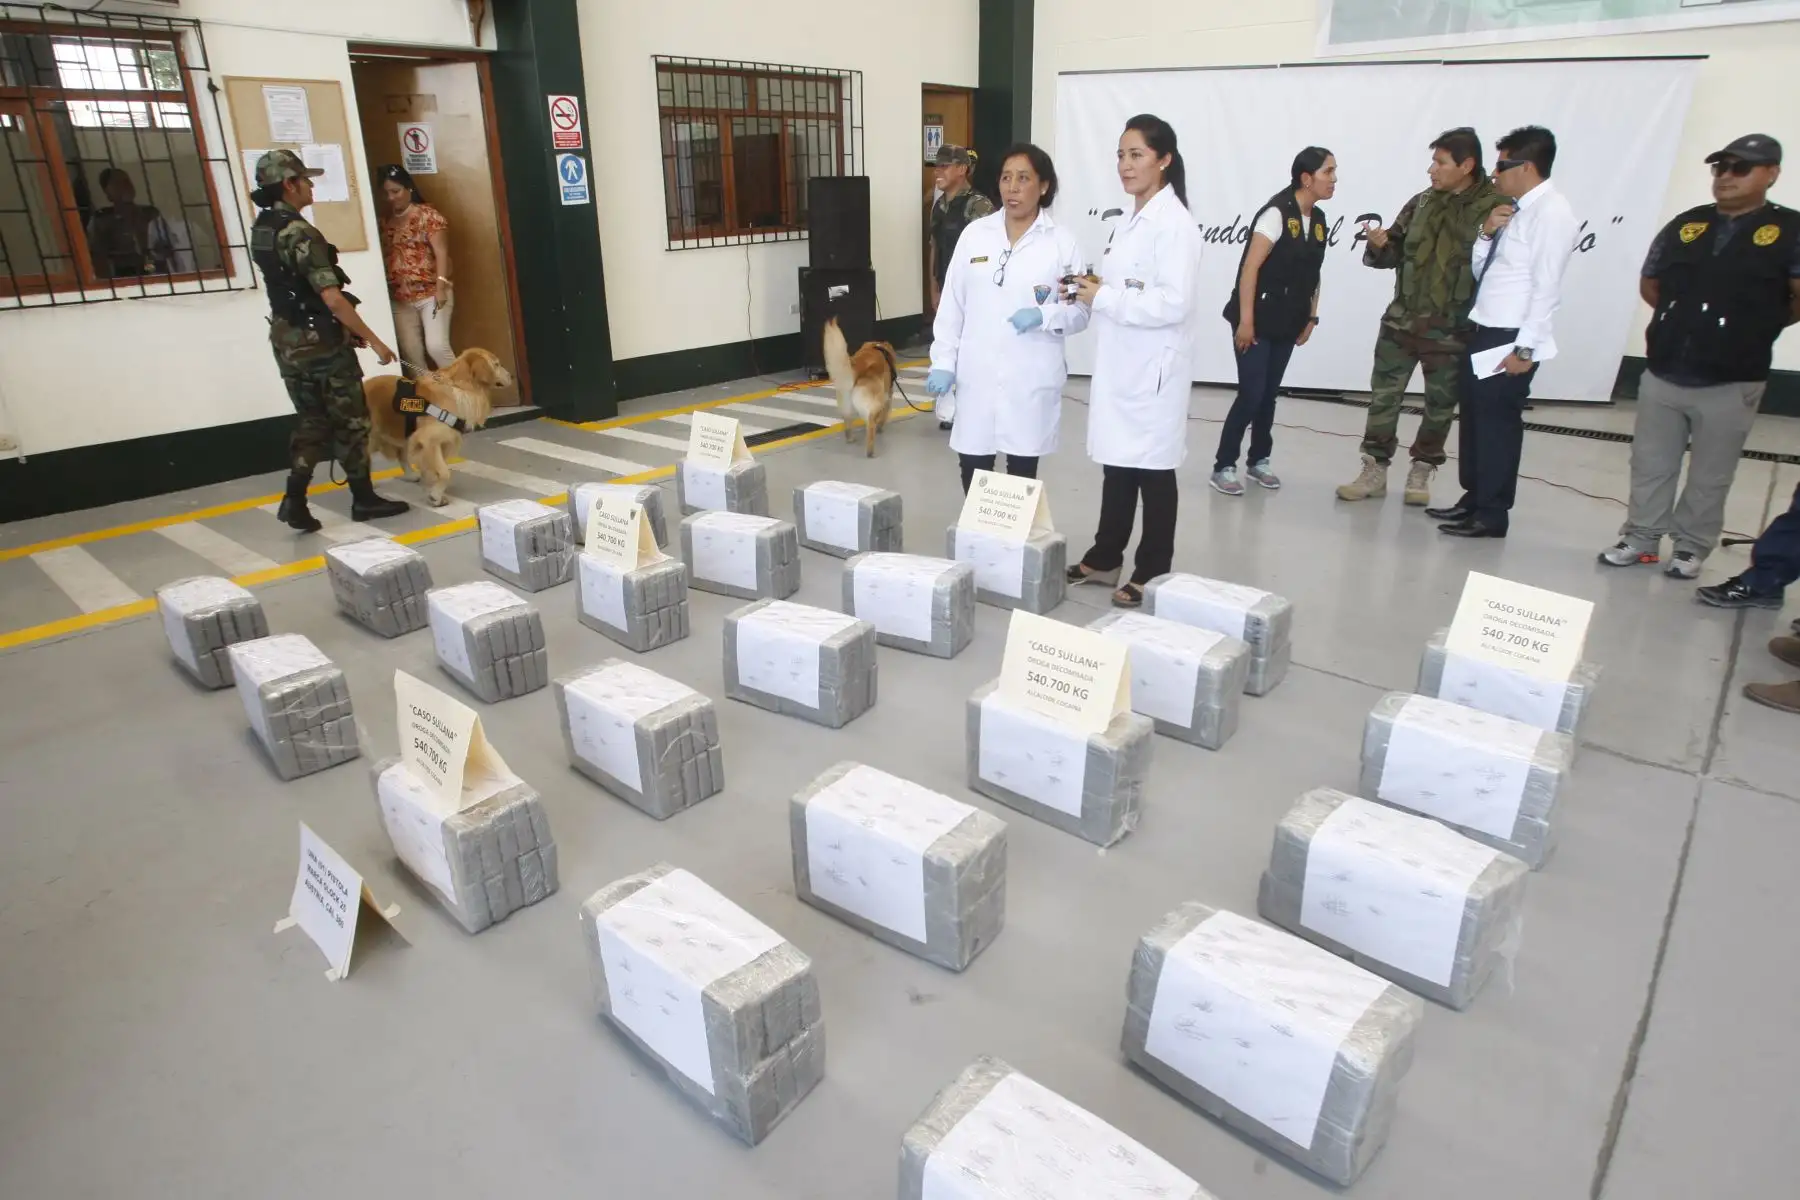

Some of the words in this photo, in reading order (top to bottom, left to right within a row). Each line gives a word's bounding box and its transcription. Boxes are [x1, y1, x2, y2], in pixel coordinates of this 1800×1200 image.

[1481, 626, 1529, 648] 540.700
[1531, 640, 1550, 653] KG
[1027, 670, 1071, 694] 540.700
[1072, 686, 1090, 701] KG
[413, 737, 438, 765] 540.700
[438, 758, 448, 774] KG
